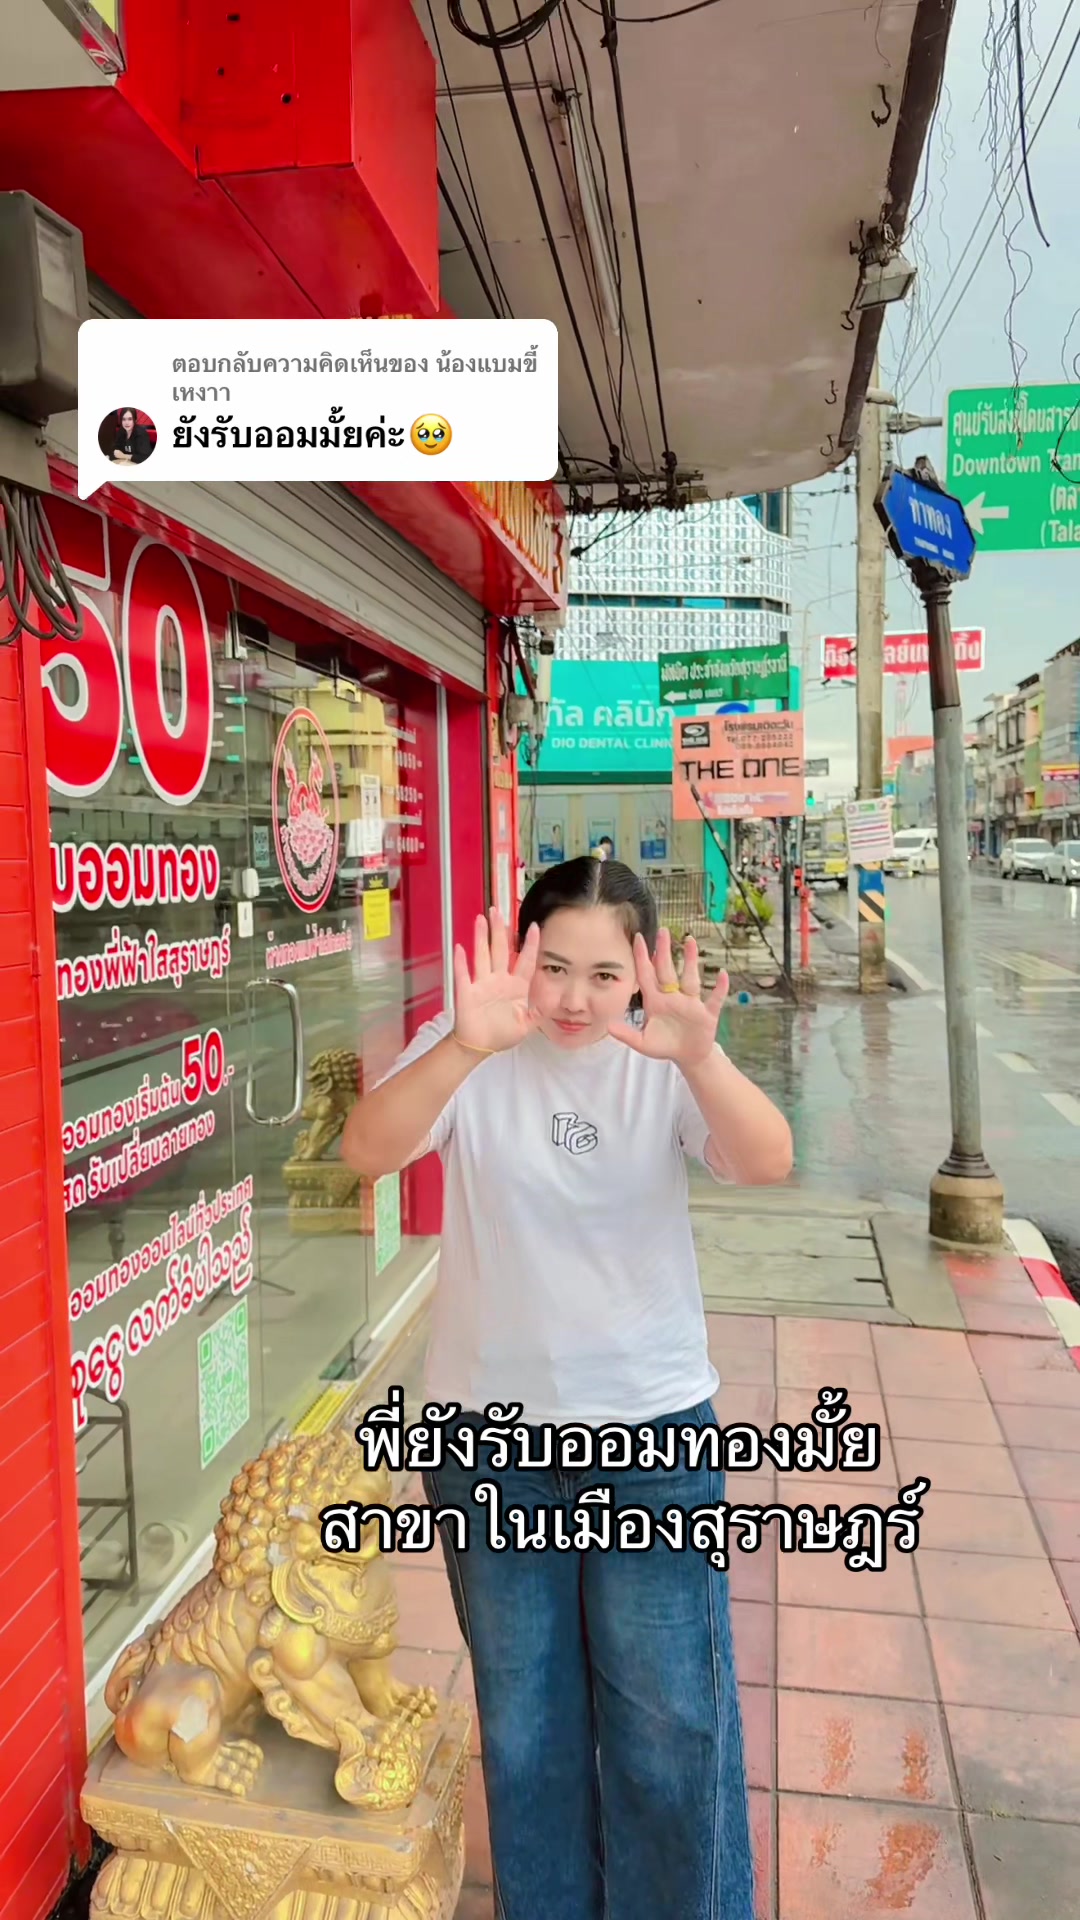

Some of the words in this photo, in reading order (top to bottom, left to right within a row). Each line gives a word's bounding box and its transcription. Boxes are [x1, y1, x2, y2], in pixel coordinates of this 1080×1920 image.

[953, 451, 1041, 477] Downtown
[593, 699, 675, 728] คลินิก
[551, 737, 576, 749] DIO
[578, 736, 631, 750] DENTAL
[679, 759, 735, 780] THE
[742, 757, 800, 778] ONE
[57, 923, 232, 1000] ทองพี่ฟ้าใสสุราษฎร์
[62, 1072, 182, 1154] ออมทองเริ่มต้น
[87, 1109, 216, 1199] รับเปลี่ยนลายทอง
[68, 1174, 253, 1322] ออมทองออนไลน์ทั่วประเทศ
